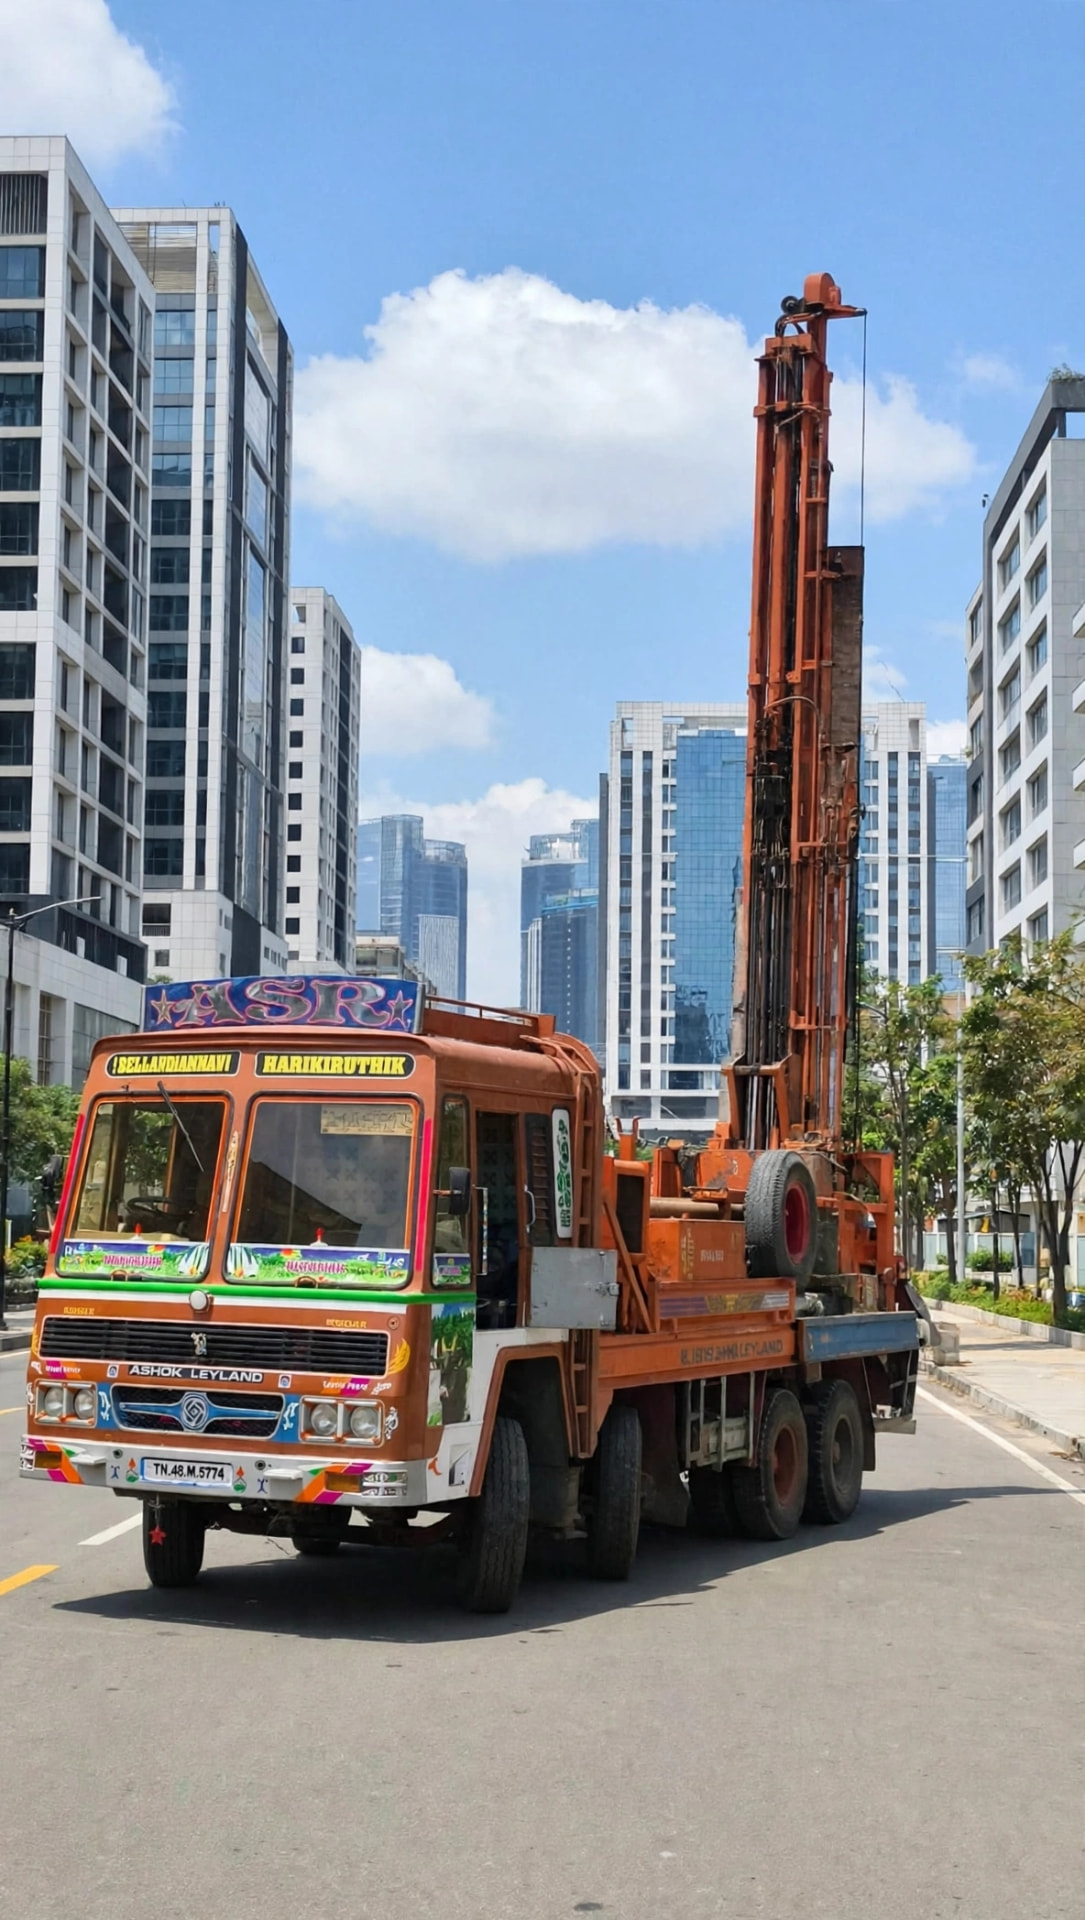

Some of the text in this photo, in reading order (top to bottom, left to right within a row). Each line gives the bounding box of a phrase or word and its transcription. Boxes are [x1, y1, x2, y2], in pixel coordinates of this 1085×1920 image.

[173, 979, 391, 1028] ASR
[261, 1054, 407, 1076] HARIKIRUTHIK
[128, 1364, 264, 1383] ASHOK LEYLAND
[152, 1463, 226, 1481] TN.48.M.5774
